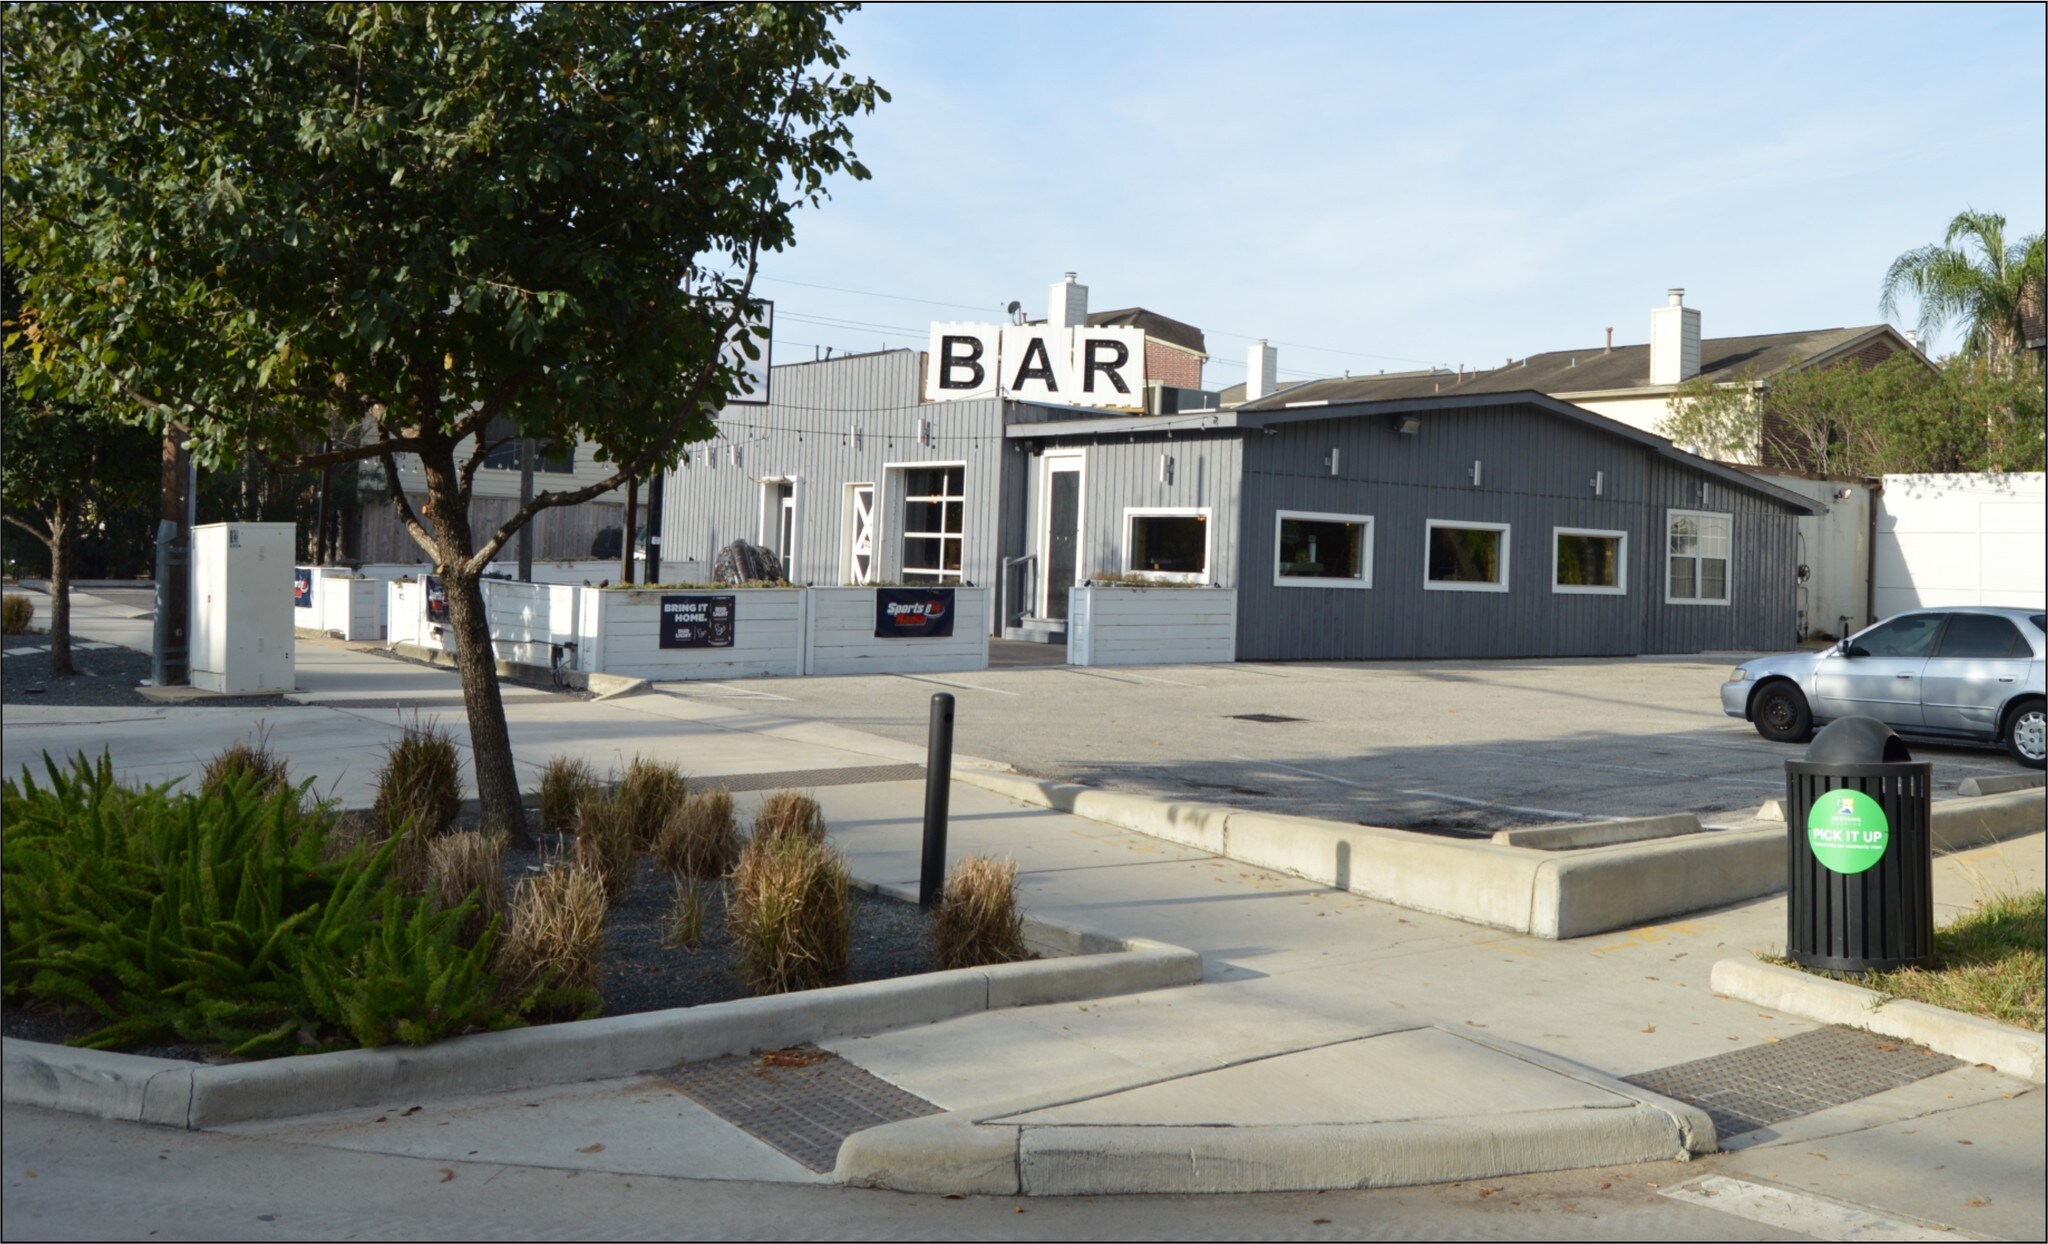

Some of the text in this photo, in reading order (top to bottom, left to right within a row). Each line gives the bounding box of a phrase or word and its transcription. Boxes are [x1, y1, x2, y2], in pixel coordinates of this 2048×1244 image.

[939, 335, 1132, 394] BAR
[664, 603, 708, 612] BRING IT
[887, 602, 924, 616] Sports
[674, 614, 708, 622] HOME.
[1813, 828, 1882, 843] PICK IT UP
